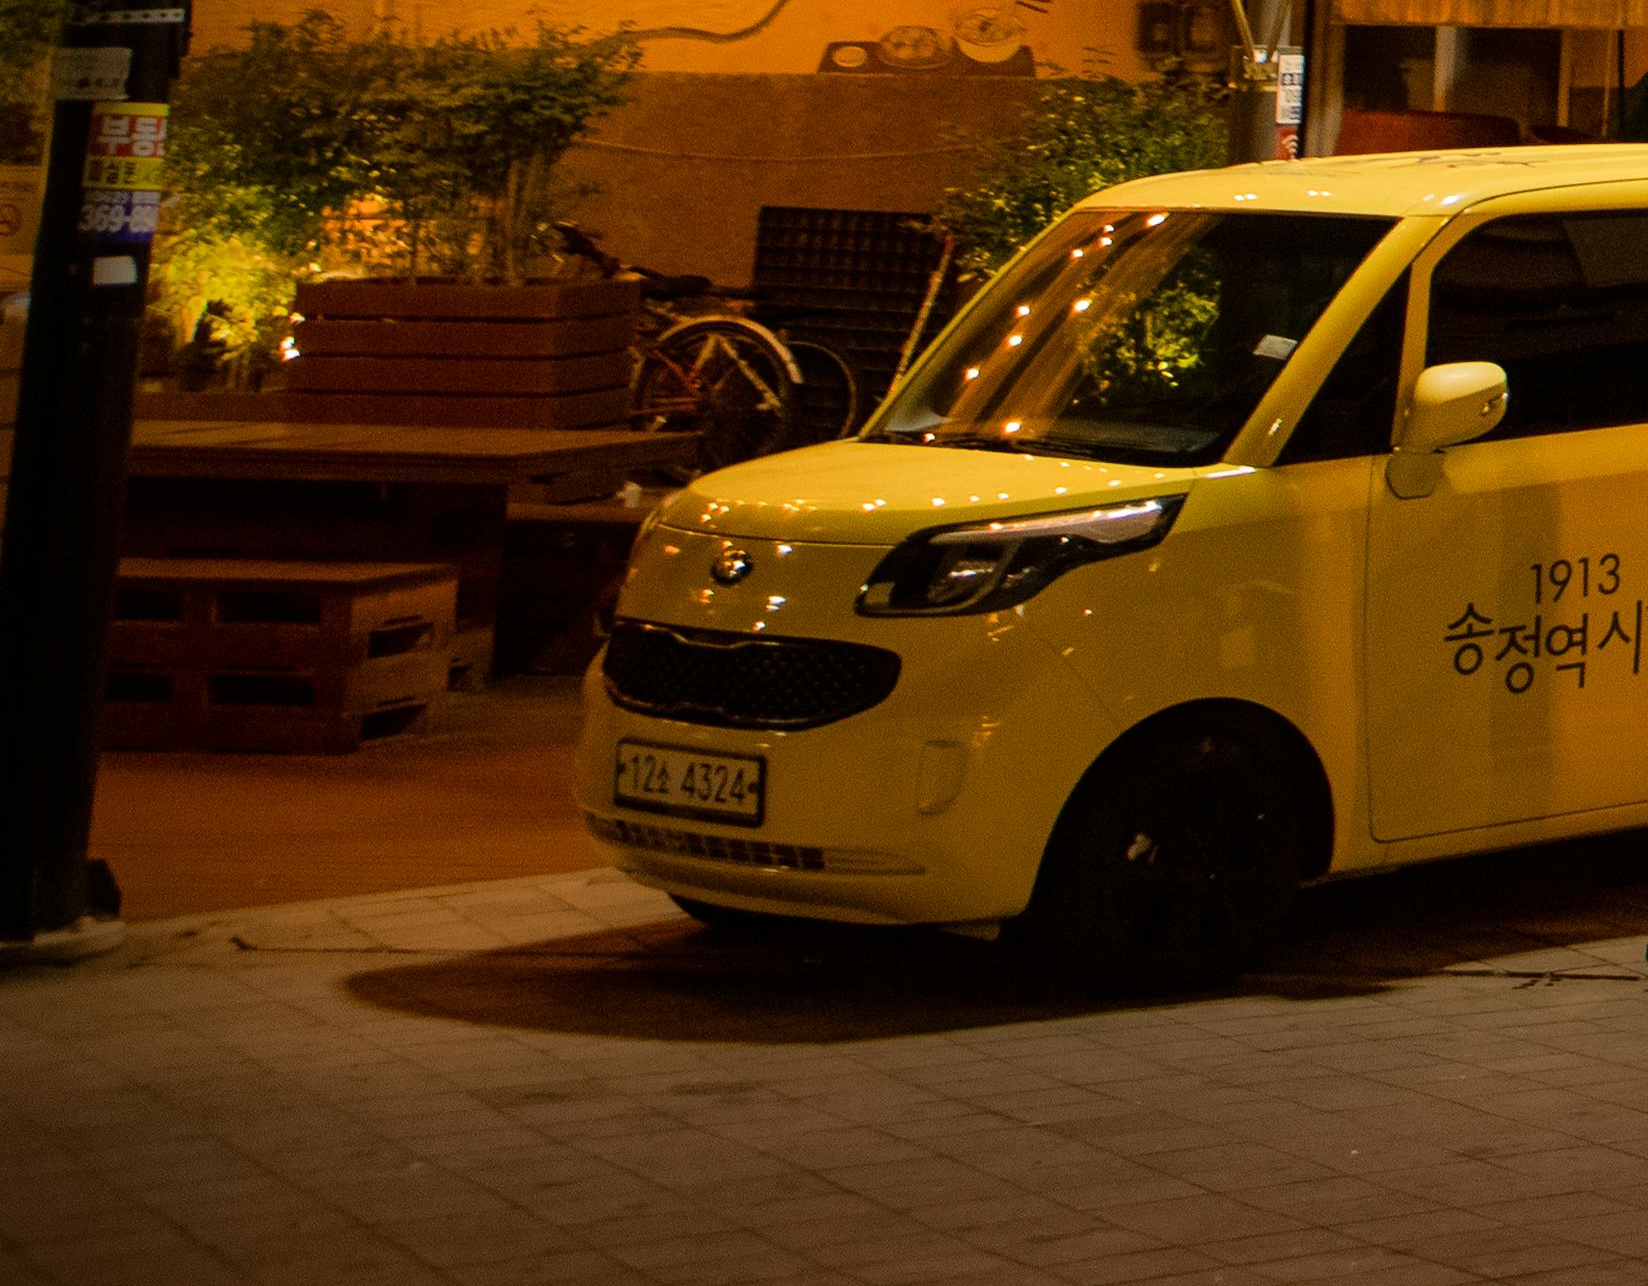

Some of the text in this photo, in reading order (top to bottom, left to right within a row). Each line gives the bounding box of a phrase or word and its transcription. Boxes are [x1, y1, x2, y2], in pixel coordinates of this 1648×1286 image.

[98, 115, 168, 156] 부동
[1530, 552, 1621, 605] 1913
[681, 762, 746, 805] 4324
